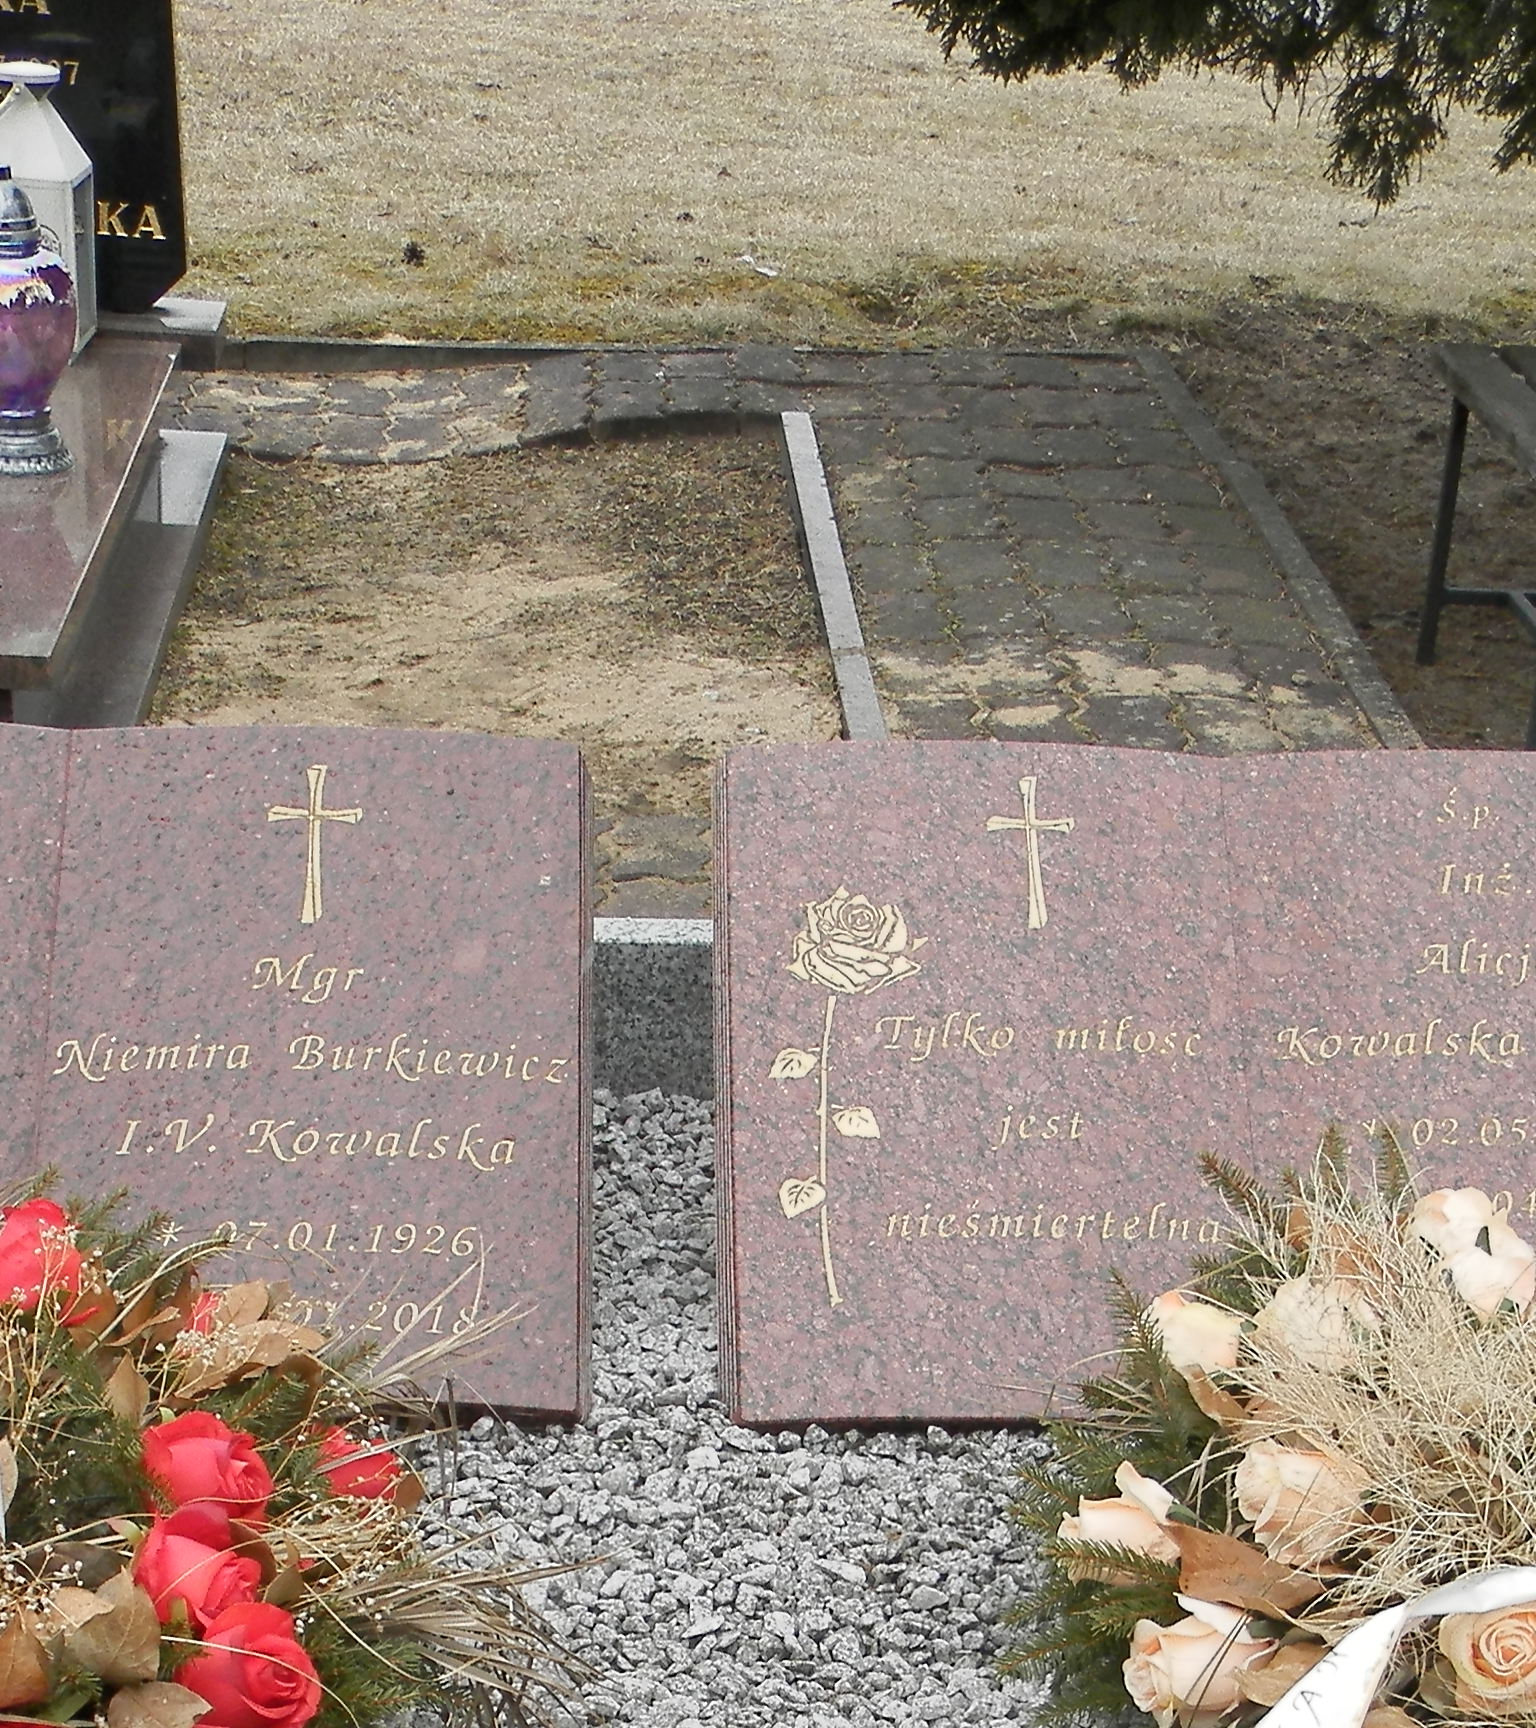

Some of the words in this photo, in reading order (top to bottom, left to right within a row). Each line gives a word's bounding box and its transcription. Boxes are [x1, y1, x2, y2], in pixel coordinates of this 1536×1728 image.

[251, 953, 365, 1004] Mgr
[52, 1032, 253, 1082] Niemira
[287, 1032, 573, 1085] Burkiewicz
[874, 1010, 1015, 1062] Tylko
[1275, 1018, 1526, 1067] Kowalska
[246, 1118, 517, 1172] Kowalska
[991, 1105, 1086, 1150] jest
[885, 1200, 1224, 1244] nieśmiertelna
